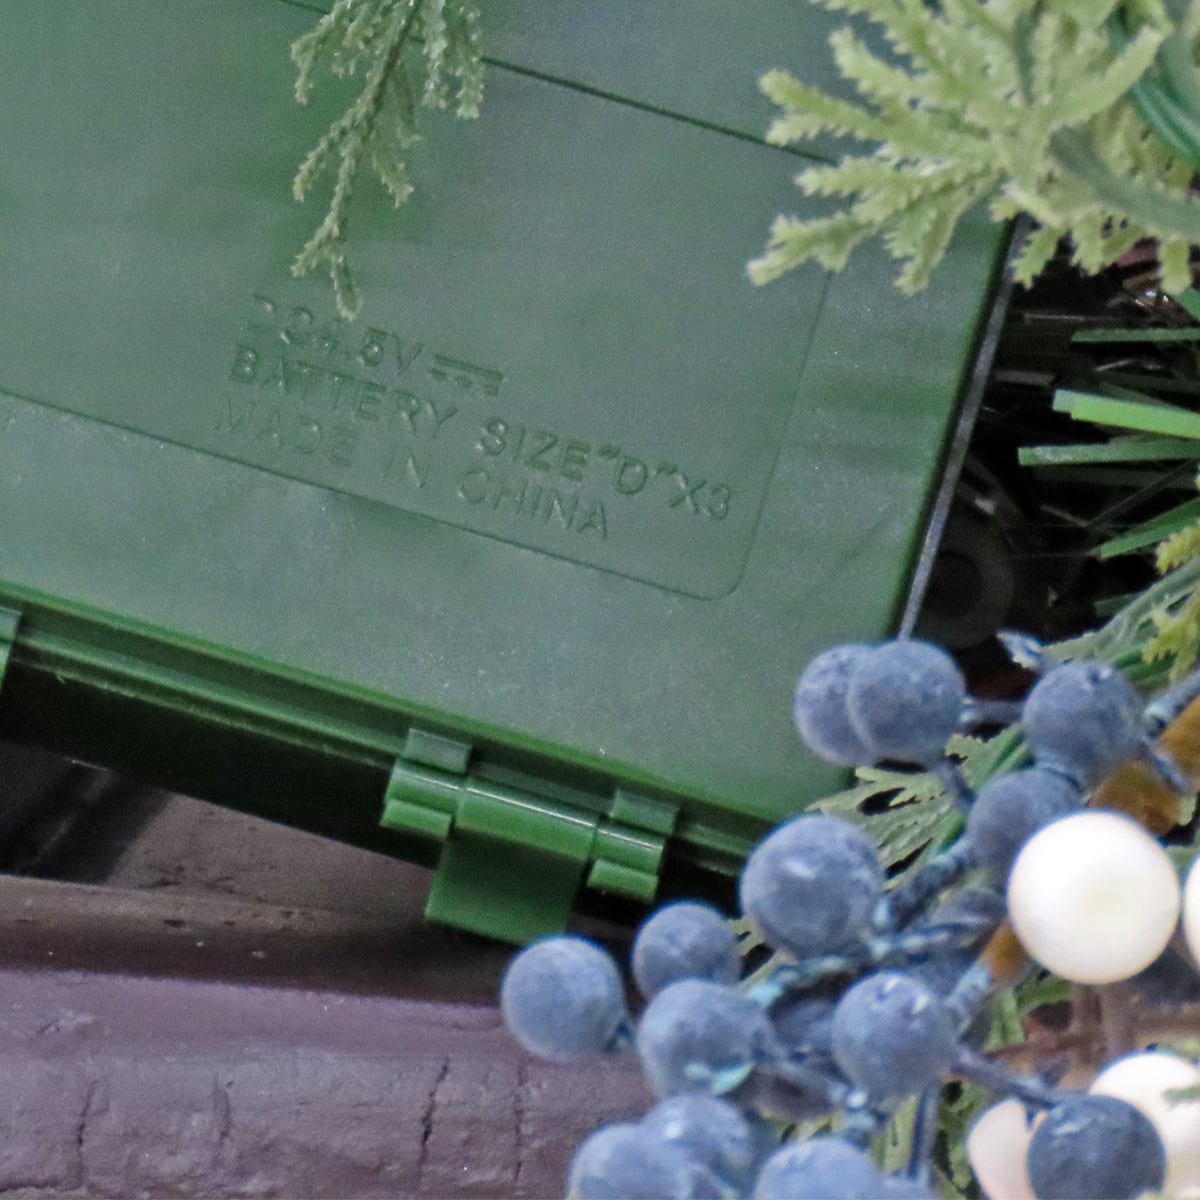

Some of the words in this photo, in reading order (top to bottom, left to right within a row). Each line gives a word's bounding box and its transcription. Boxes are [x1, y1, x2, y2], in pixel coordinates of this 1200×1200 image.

[229, 344, 458, 438] BATTERY
[213, 394, 359, 468] MADE
[382, 442, 434, 489] IN
[456, 466, 610, 541] CHINA
